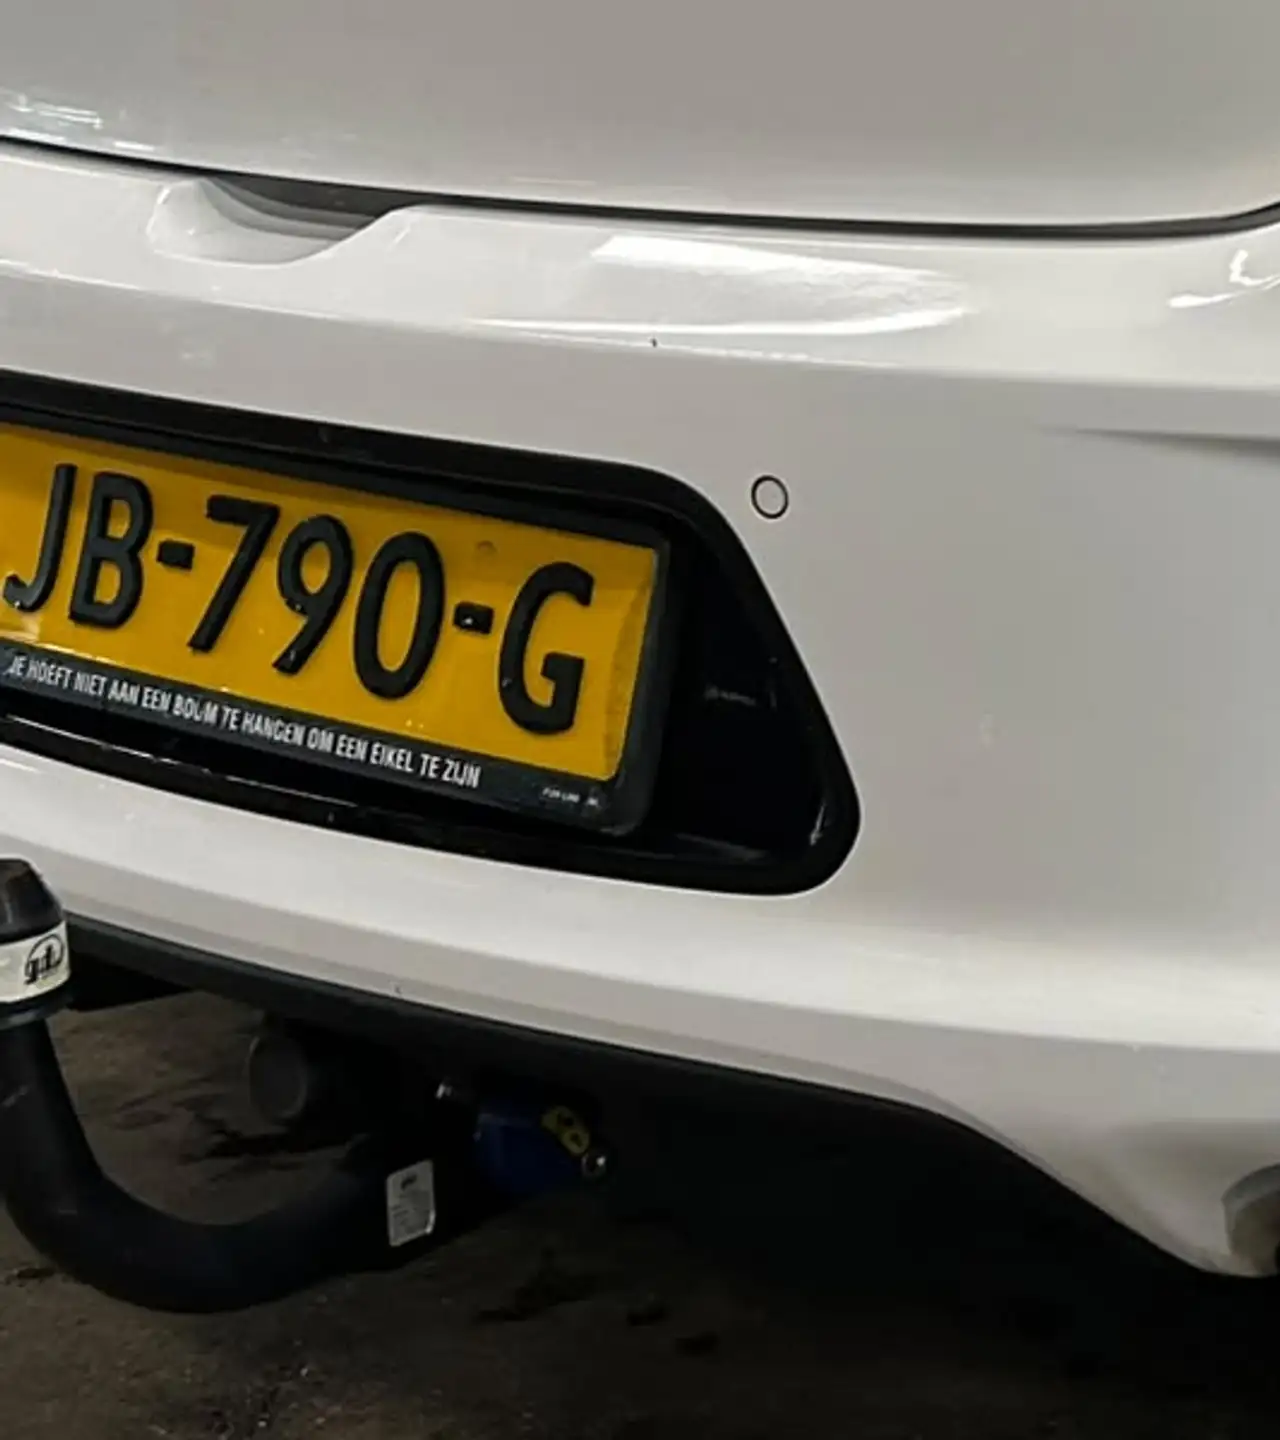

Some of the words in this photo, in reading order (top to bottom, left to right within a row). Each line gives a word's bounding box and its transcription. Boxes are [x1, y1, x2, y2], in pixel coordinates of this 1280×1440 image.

[3, 463, 595, 735] JB-790-G
[27, 658, 73, 690] HOEFT
[73, 670, 108, 698] NIET
[107, 679, 141, 706] AAN
[141, 686, 173, 712] EEN
[221, 705, 242, 732] TE
[241, 708, 306, 746] HANGEN
[306, 728, 335, 754] OM
[335, 735, 369, 762] EEN
[370, 744, 414, 773] EIKEL
[418, 753, 443, 779] TE
[441, 759, 482, 789] ZIJN
